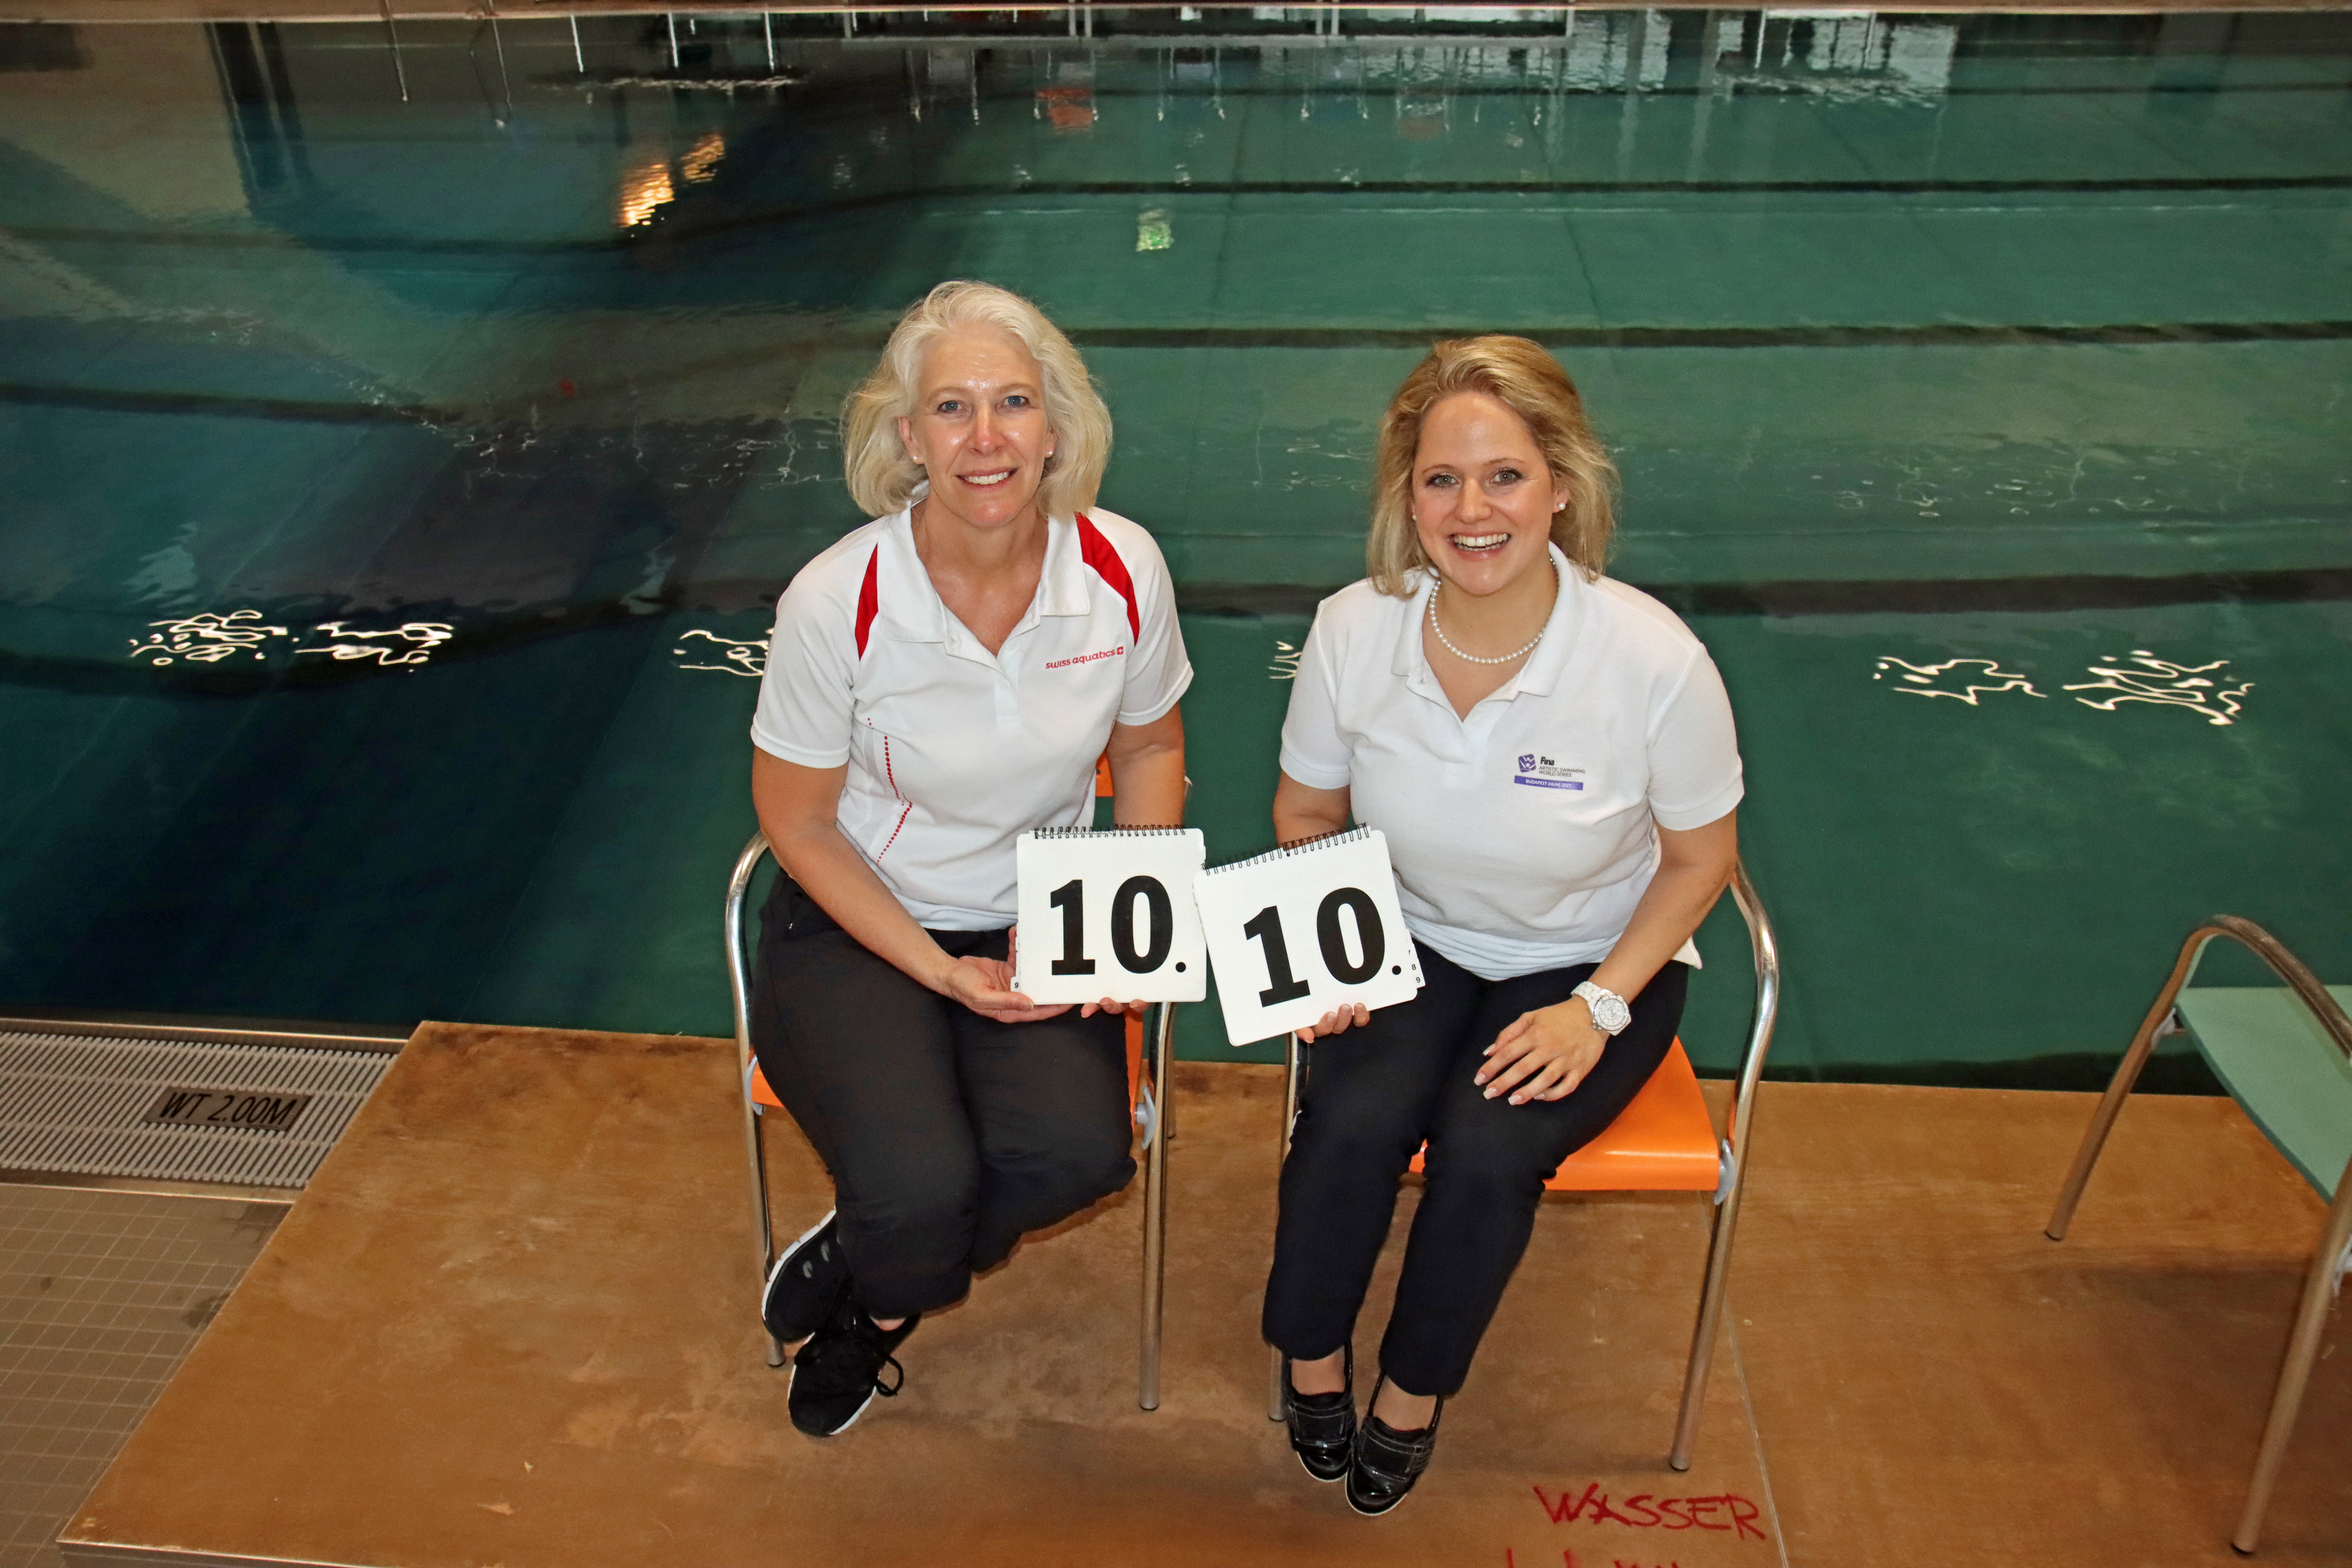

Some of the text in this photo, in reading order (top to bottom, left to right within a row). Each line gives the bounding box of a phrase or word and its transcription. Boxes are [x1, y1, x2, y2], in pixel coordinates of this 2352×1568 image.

[1046, 649, 1115, 669] swiss aquatics
[1050, 875, 1186, 976] 10.
[1243, 887, 1402, 1008] 10.
[159, 1092, 298, 1125] WT 2.00M
[1533, 1483, 1766, 1540] WASSER
